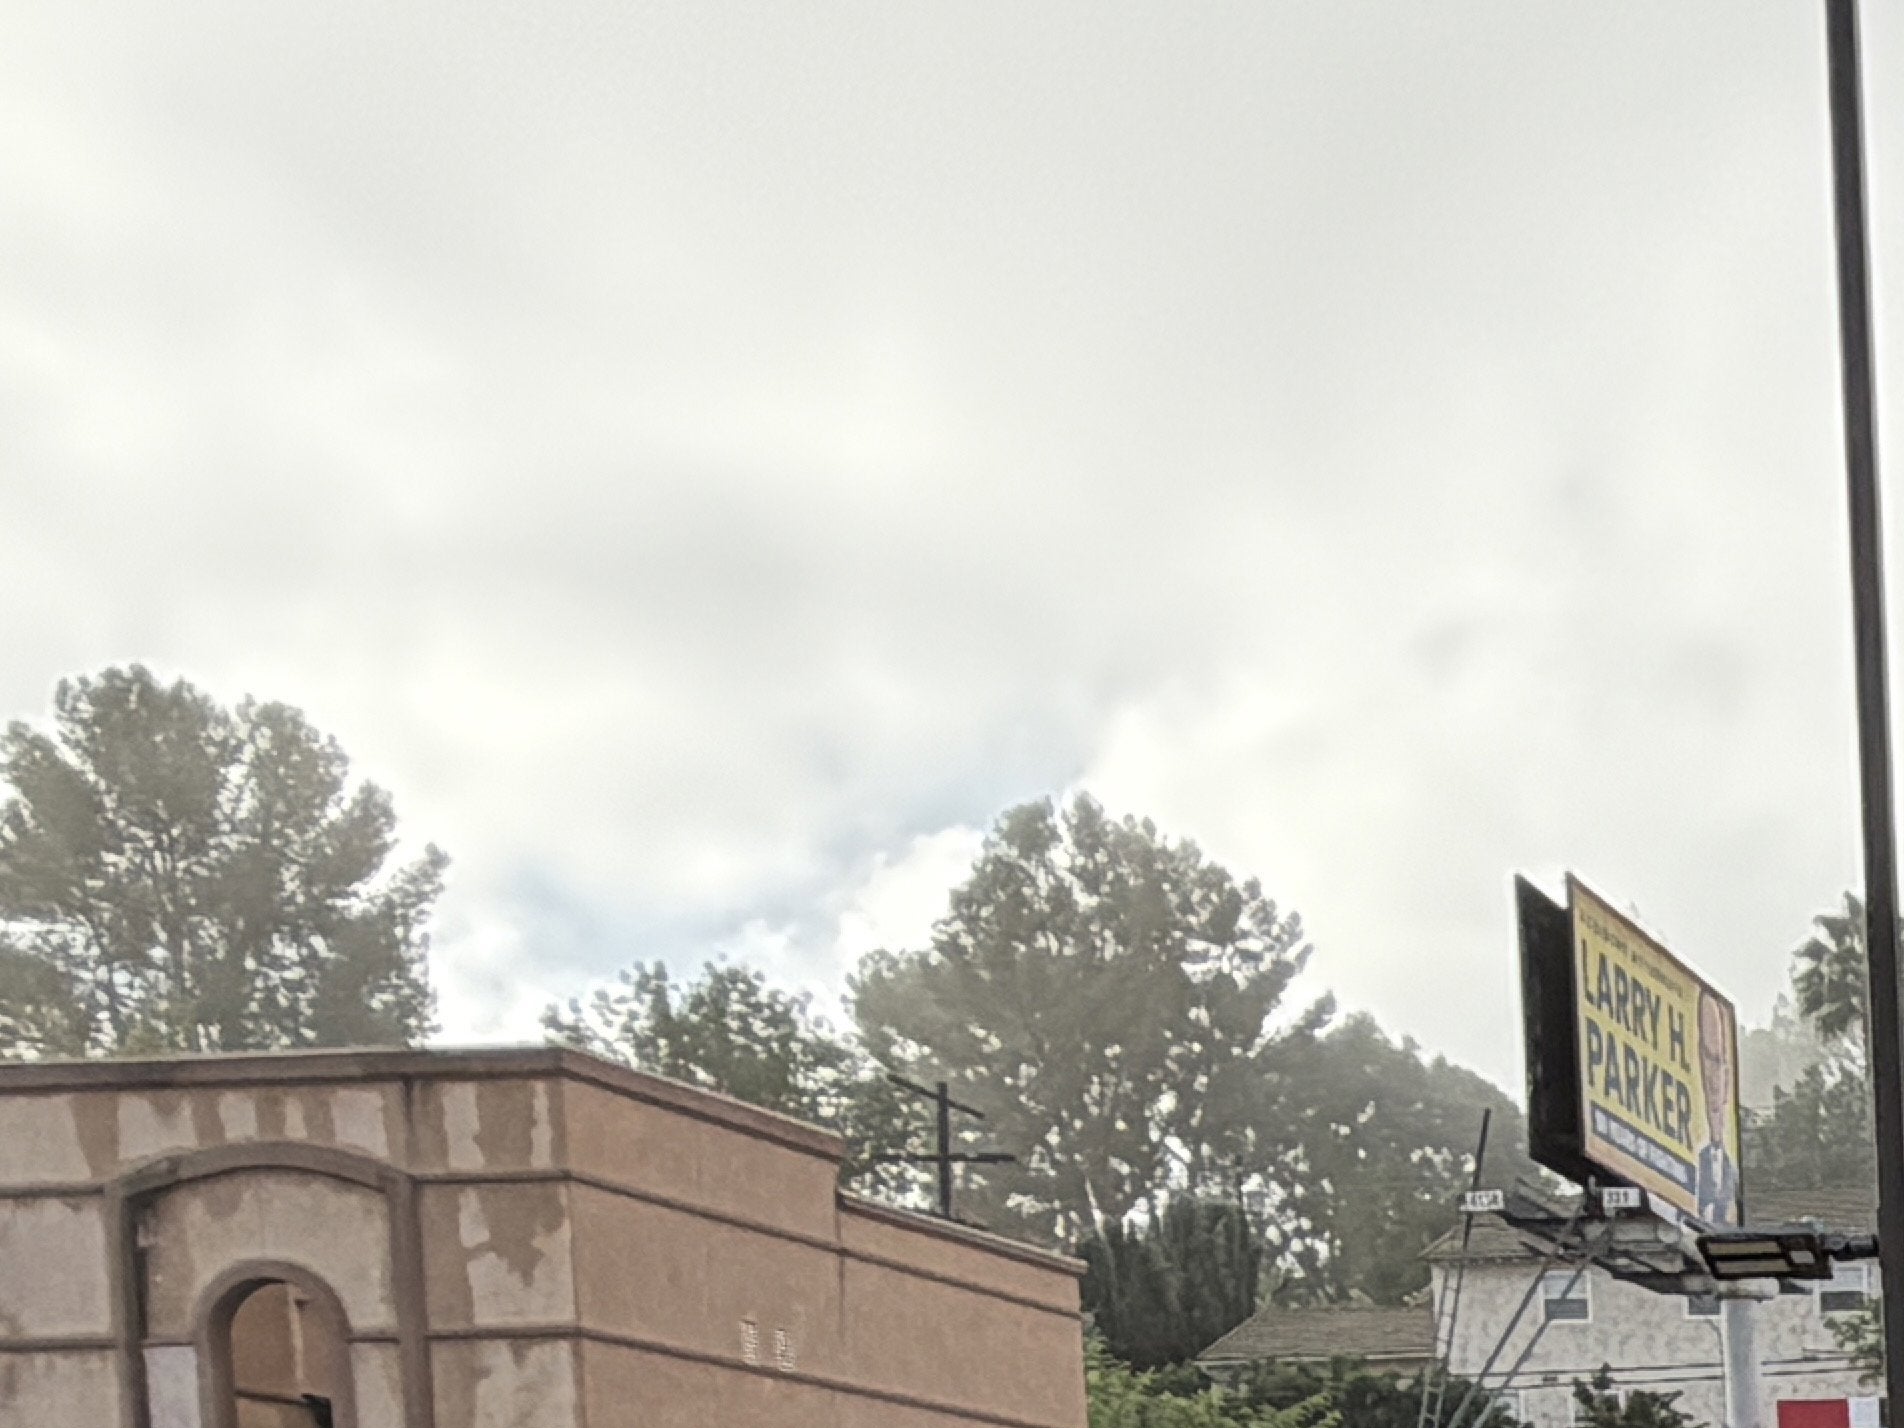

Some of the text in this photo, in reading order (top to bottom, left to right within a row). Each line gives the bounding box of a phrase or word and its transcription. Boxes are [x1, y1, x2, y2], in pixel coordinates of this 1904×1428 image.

[1580, 938, 1691, 1073] LARRY H.
[1585, 1016, 1693, 1154] PARKER
